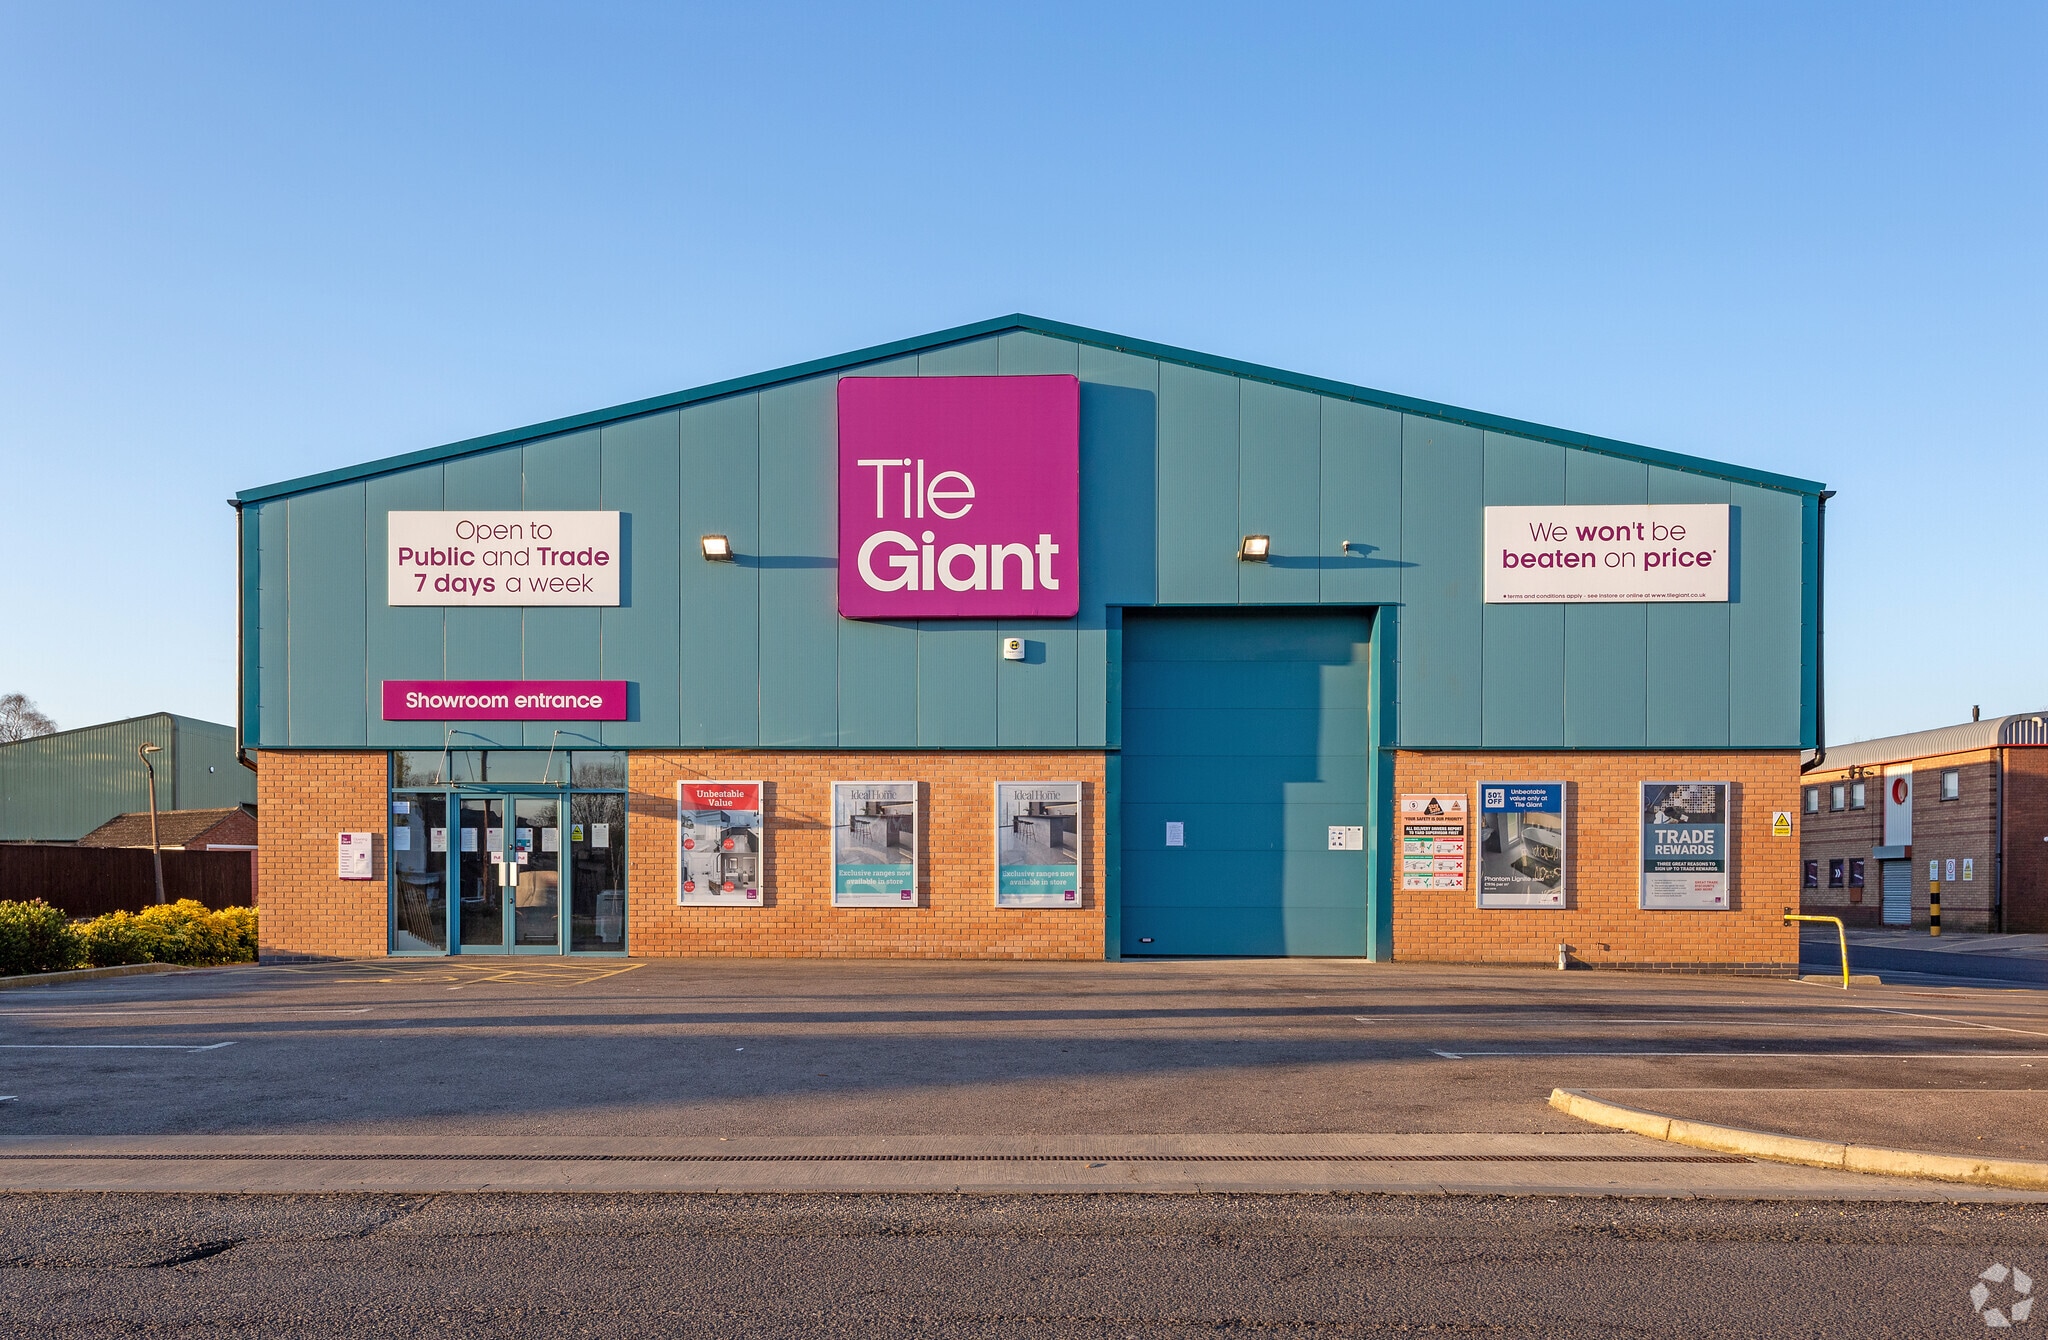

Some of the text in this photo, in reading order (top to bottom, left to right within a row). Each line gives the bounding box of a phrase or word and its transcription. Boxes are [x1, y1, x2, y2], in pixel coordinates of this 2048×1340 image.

[857, 457, 976, 520] Tile
[456, 520, 553, 543] Open to
[1529, 521, 1686, 542] We won't be
[398, 547, 610, 566] Public and Trade
[857, 530, 1060, 592] Giant
[1502, 549, 1596, 569] beaten
[1604, 551, 1636, 568] on
[414, 573, 594, 596] 7 days a week
[405, 691, 603, 709] Showroom entrance
[696, 790, 744, 798] Unbeatable
[708, 799, 733, 807] Value
[851, 790, 897, 800] Ideal Home
[1014, 790, 1061, 800] Ideal Home
[1655, 829, 1714, 844] TRADE
[1655, 845, 1714, 855] REWARDS
